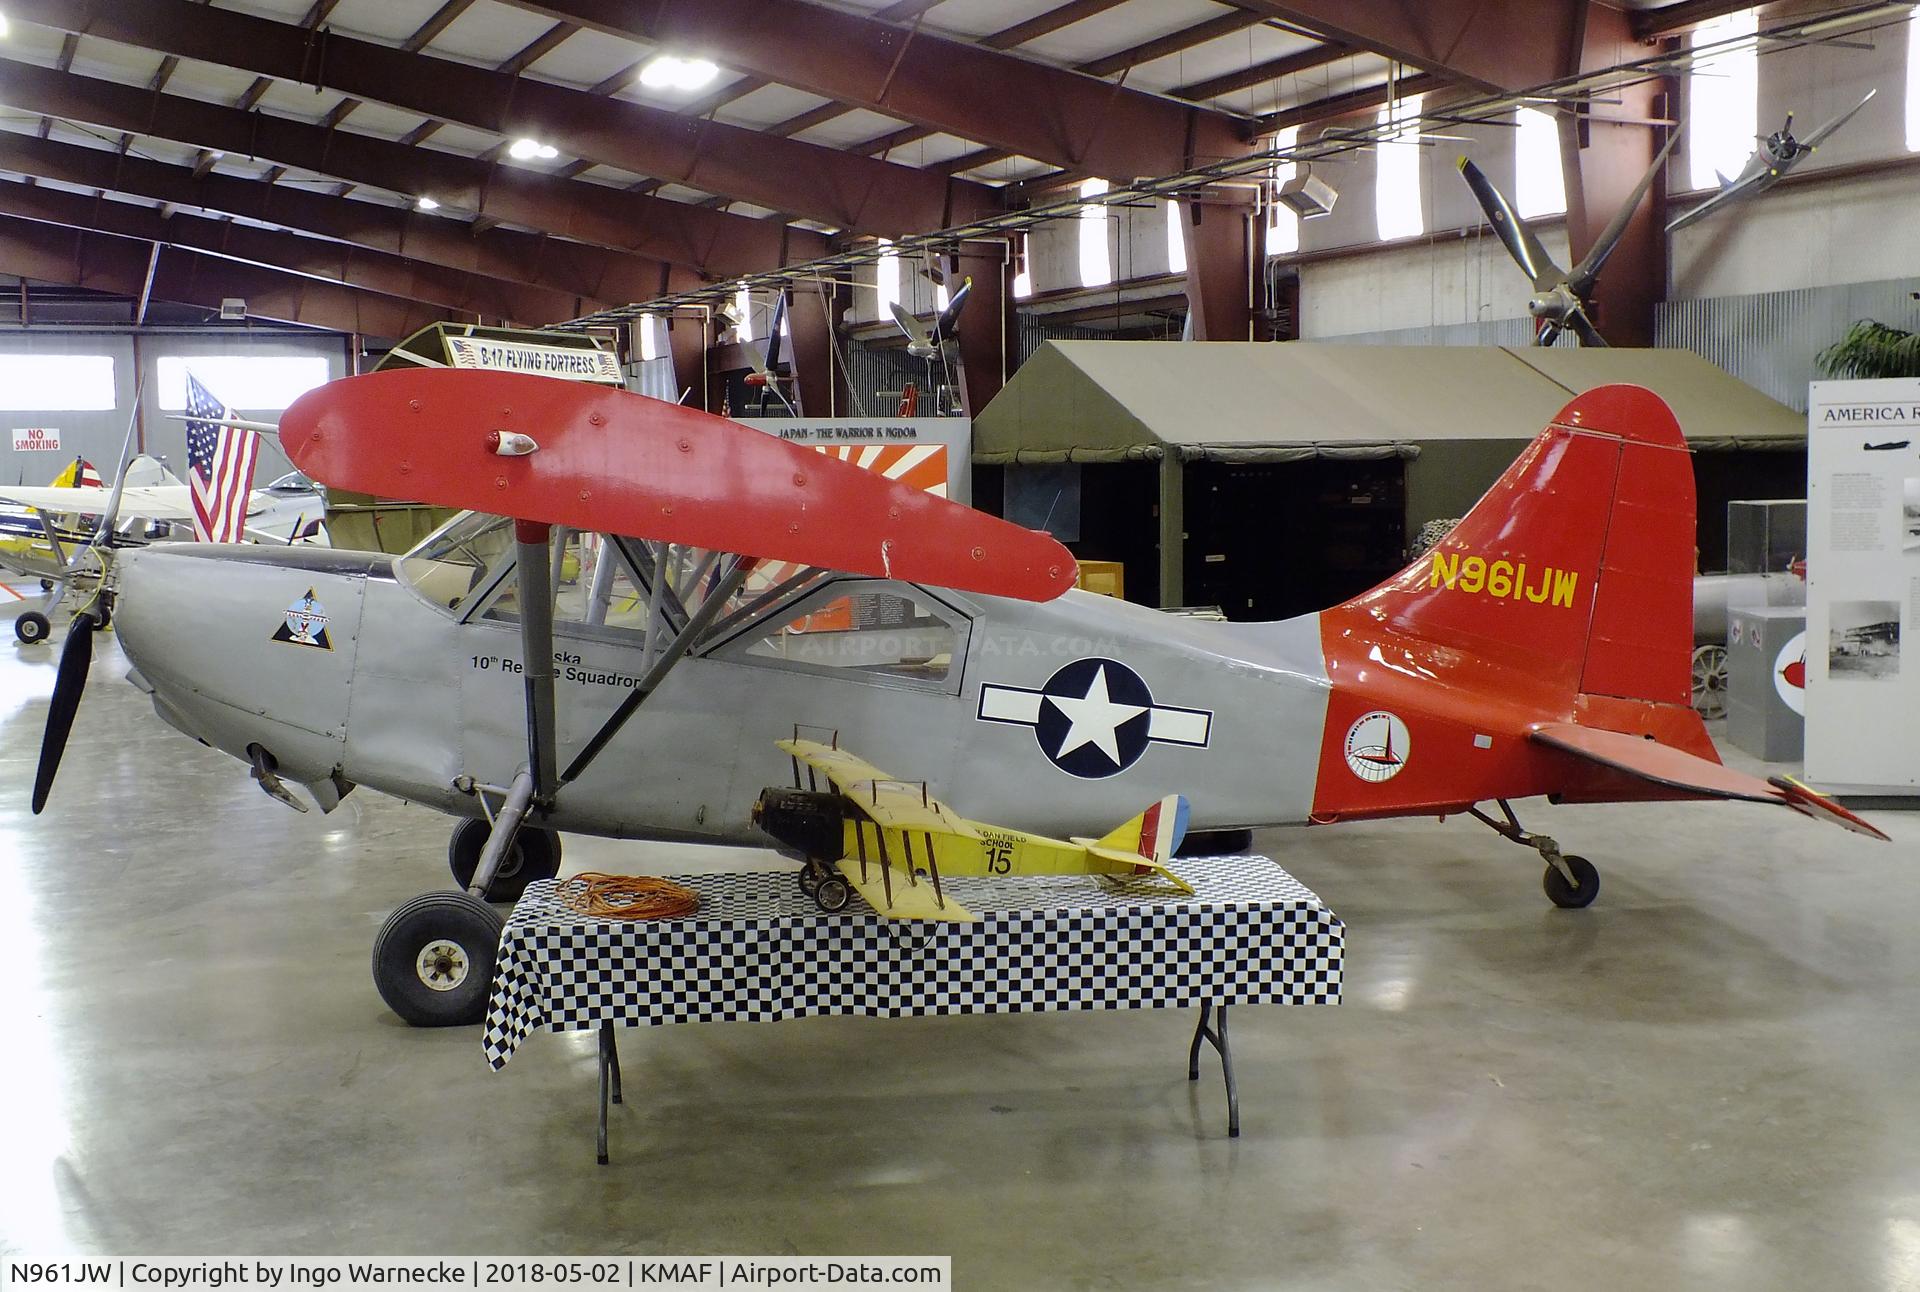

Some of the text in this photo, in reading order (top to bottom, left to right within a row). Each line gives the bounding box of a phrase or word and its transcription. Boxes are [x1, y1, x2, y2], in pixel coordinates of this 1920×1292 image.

[480, 346, 596, 374] B-17 FLYING FORTRESS
[1824, 407, 1905, 421] AMERICA
[28, 429, 44, 439] NO
[778, 427, 808, 439] JAPAN
[815, 427, 834, 439] THE
[835, 427, 874, 439] WARRIOR
[15, 439, 59, 450] SMOKING
[1430, 551, 1579, 608] N961JW
[554, 651, 582, 665] ska
[986, 847, 1012, 875] 15
